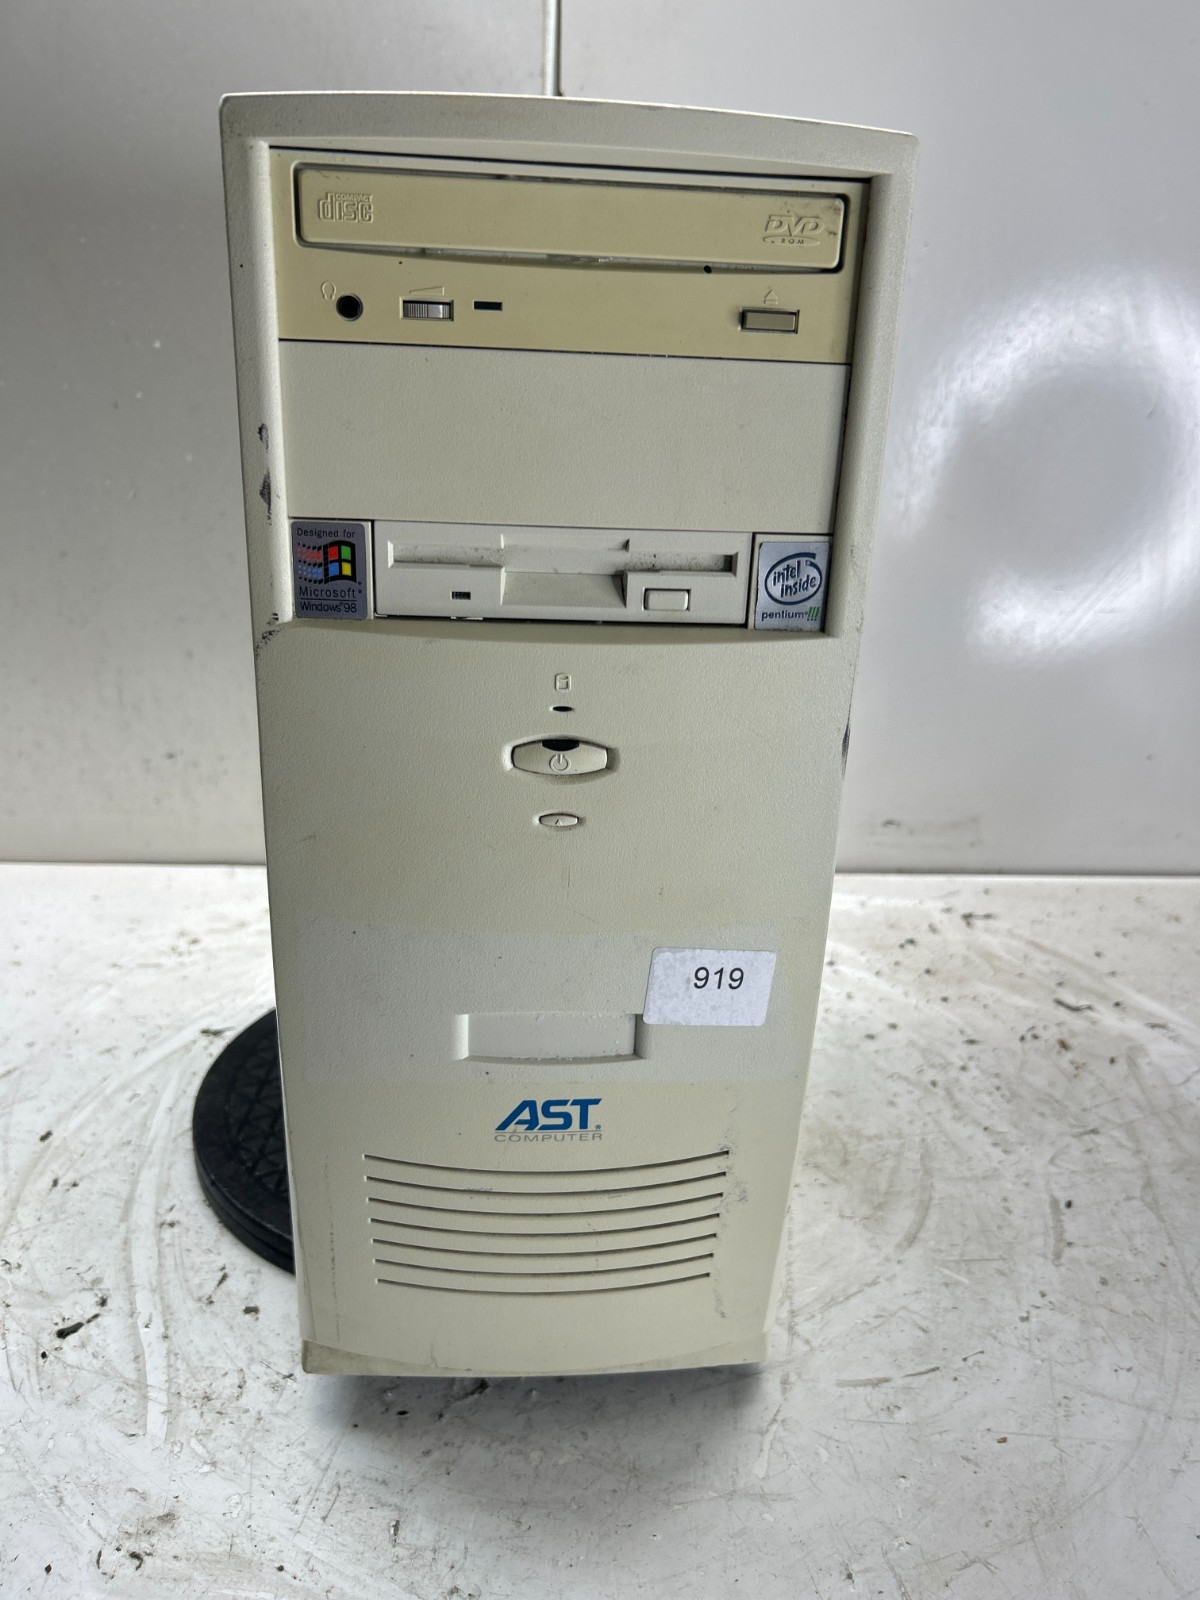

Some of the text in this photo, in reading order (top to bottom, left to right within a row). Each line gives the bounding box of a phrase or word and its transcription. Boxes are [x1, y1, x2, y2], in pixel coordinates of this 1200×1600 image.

[318, 192, 374, 224] disc
[765, 215, 825, 237] DVD
[297, 527, 356, 538] Designed for
[773, 560, 801, 586] intel
[300, 586, 357, 598] Microsoft
[780, 574, 817, 598] inside
[761, 610, 805, 621] pentium
[693, 966, 744, 990] 919
[495, 1098, 602, 1131] AST
[494, 1133, 603, 1142] COMPUTER
